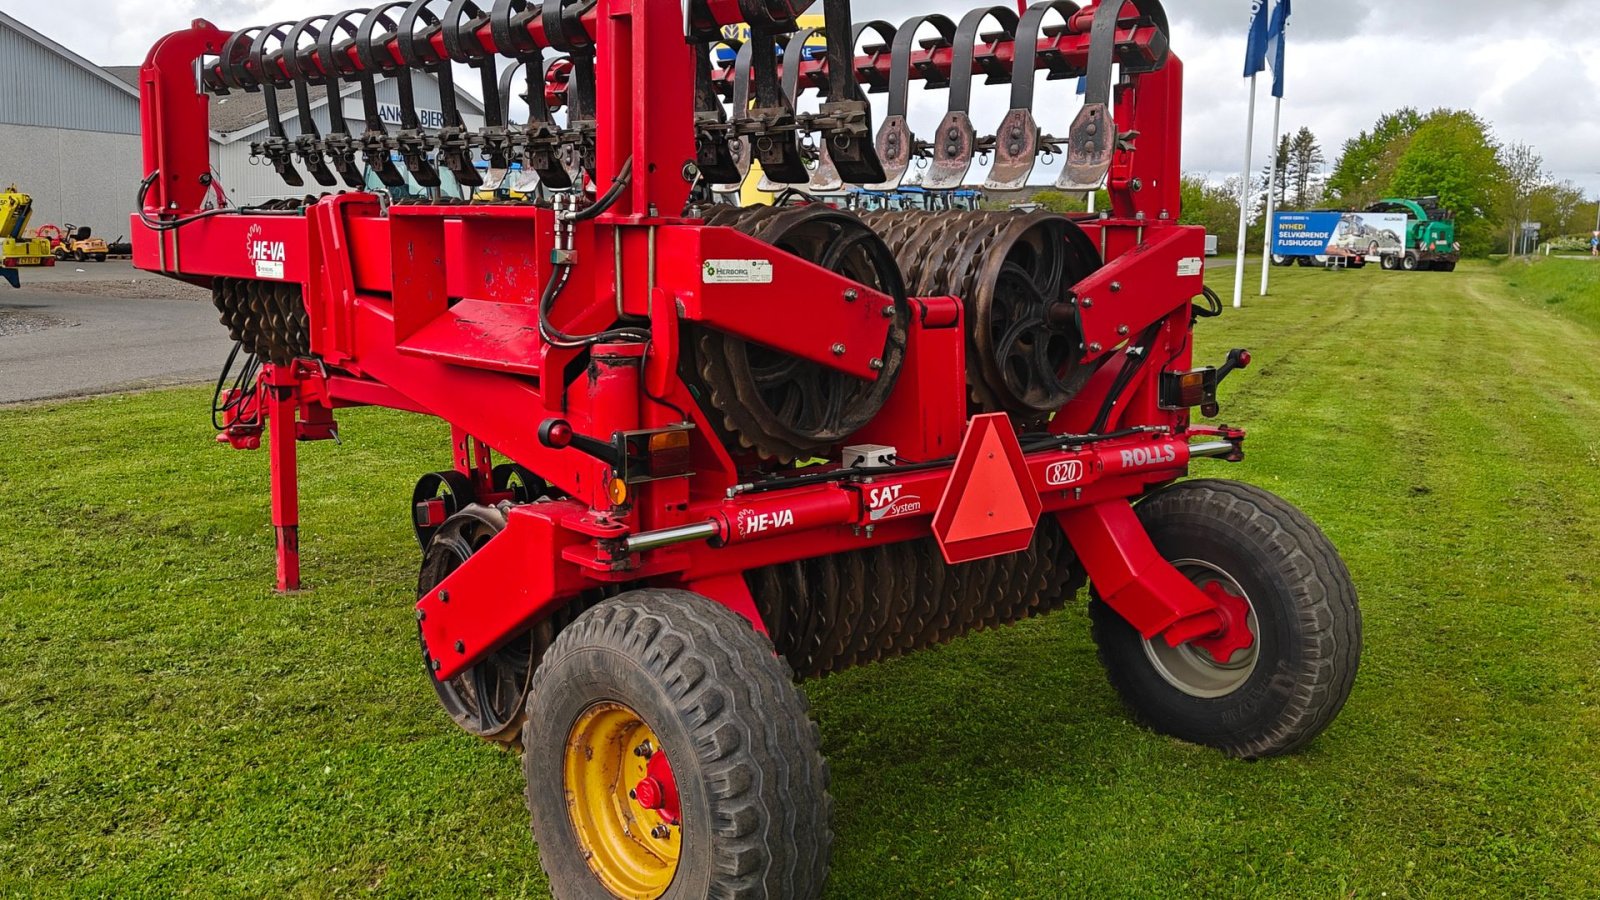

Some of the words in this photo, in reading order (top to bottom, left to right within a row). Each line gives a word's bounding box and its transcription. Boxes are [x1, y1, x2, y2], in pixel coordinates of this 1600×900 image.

[1279, 231, 1329, 239] SELVKØRENDE
[253, 241, 286, 261] HE-VA
[1119, 444, 1176, 468] ROLLS
[1052, 462, 1076, 483] 820
[870, 484, 902, 508] SAT
[891, 501, 920, 515] System
[746, 509, 794, 534] HE-VA
